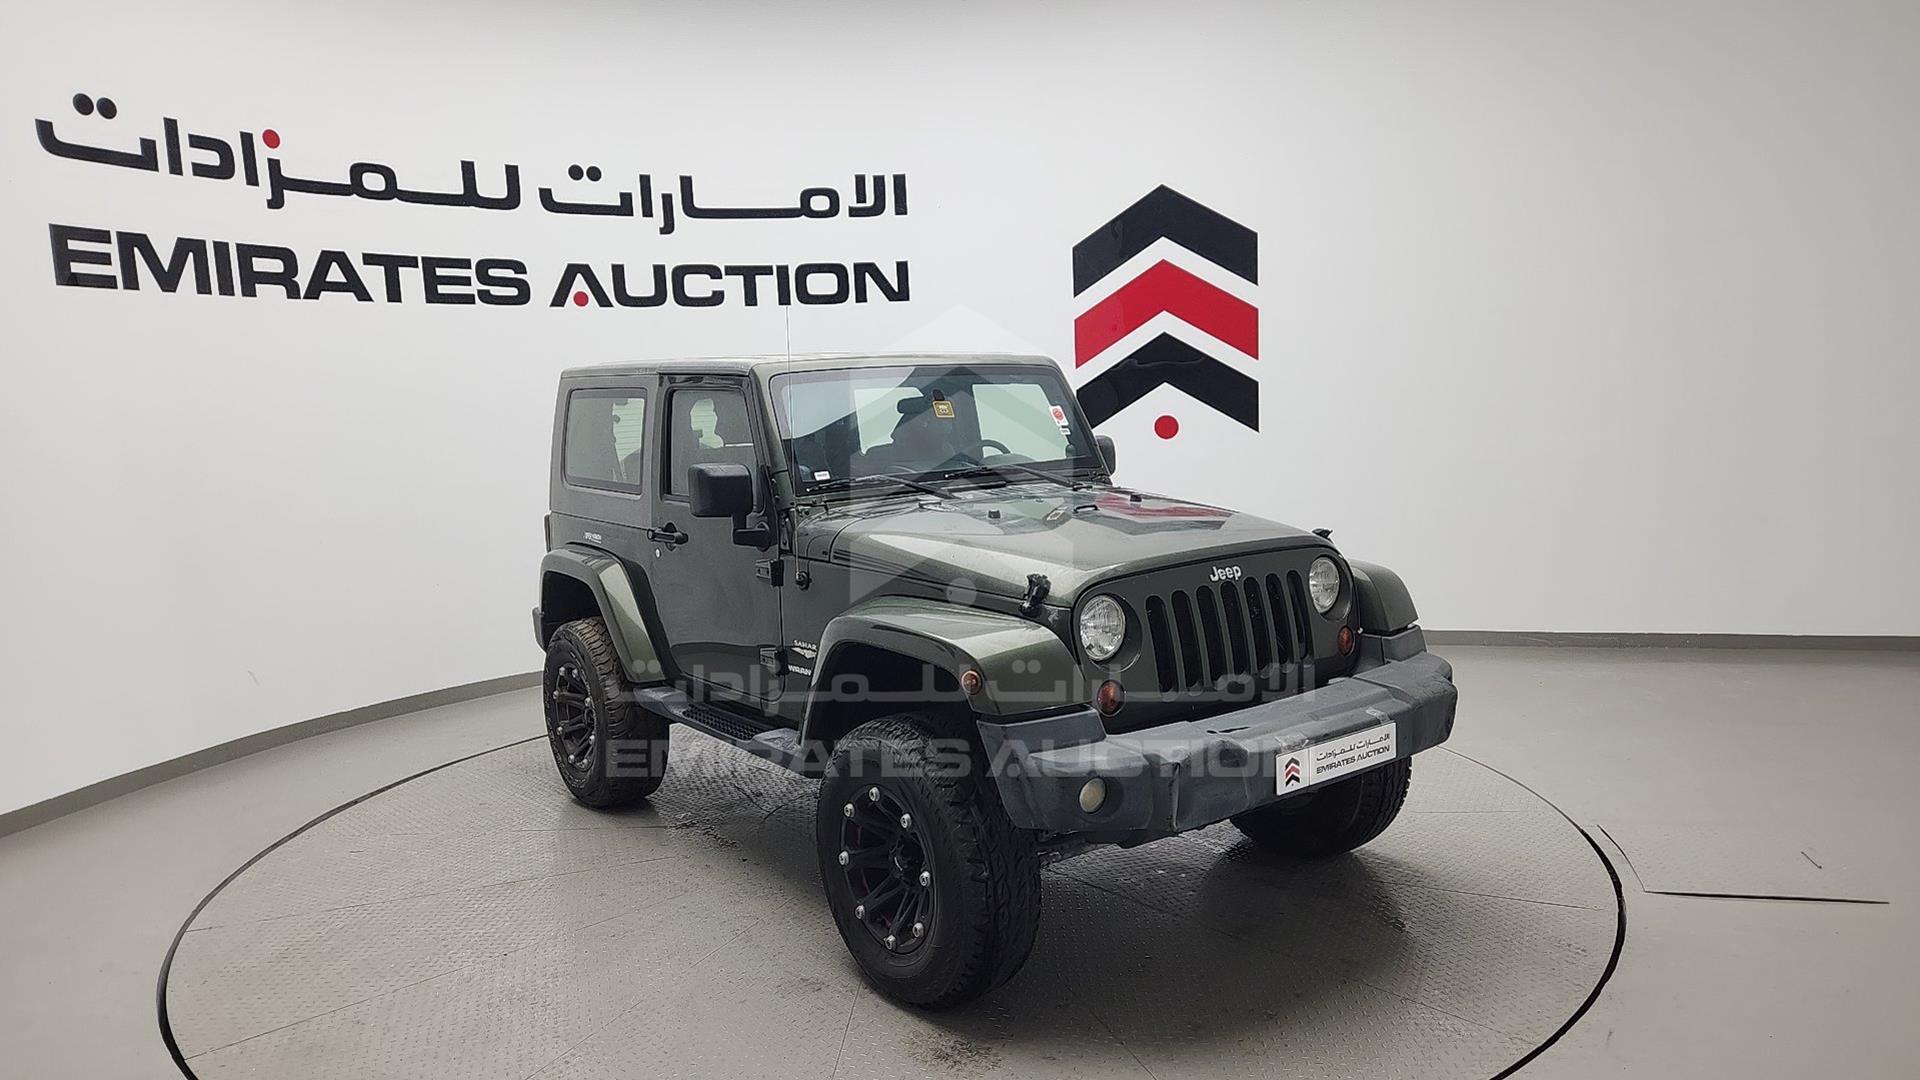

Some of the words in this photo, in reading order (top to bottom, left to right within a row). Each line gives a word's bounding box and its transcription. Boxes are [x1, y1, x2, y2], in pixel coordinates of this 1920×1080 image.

[36, 93, 521, 211] للمزادات
[539, 164, 908, 235] الامارات
[49, 223, 531, 307] EMIRATES
[549, 262, 910, 308] AUCTION
[1210, 566, 1241, 581] Jeep
[1316, 744, 1356, 762] للمزادات
[1356, 733, 1391, 749] الامارات
[1316, 755, 1356, 775] EMIRATES
[1356, 744, 1391, 762] AUCTION
